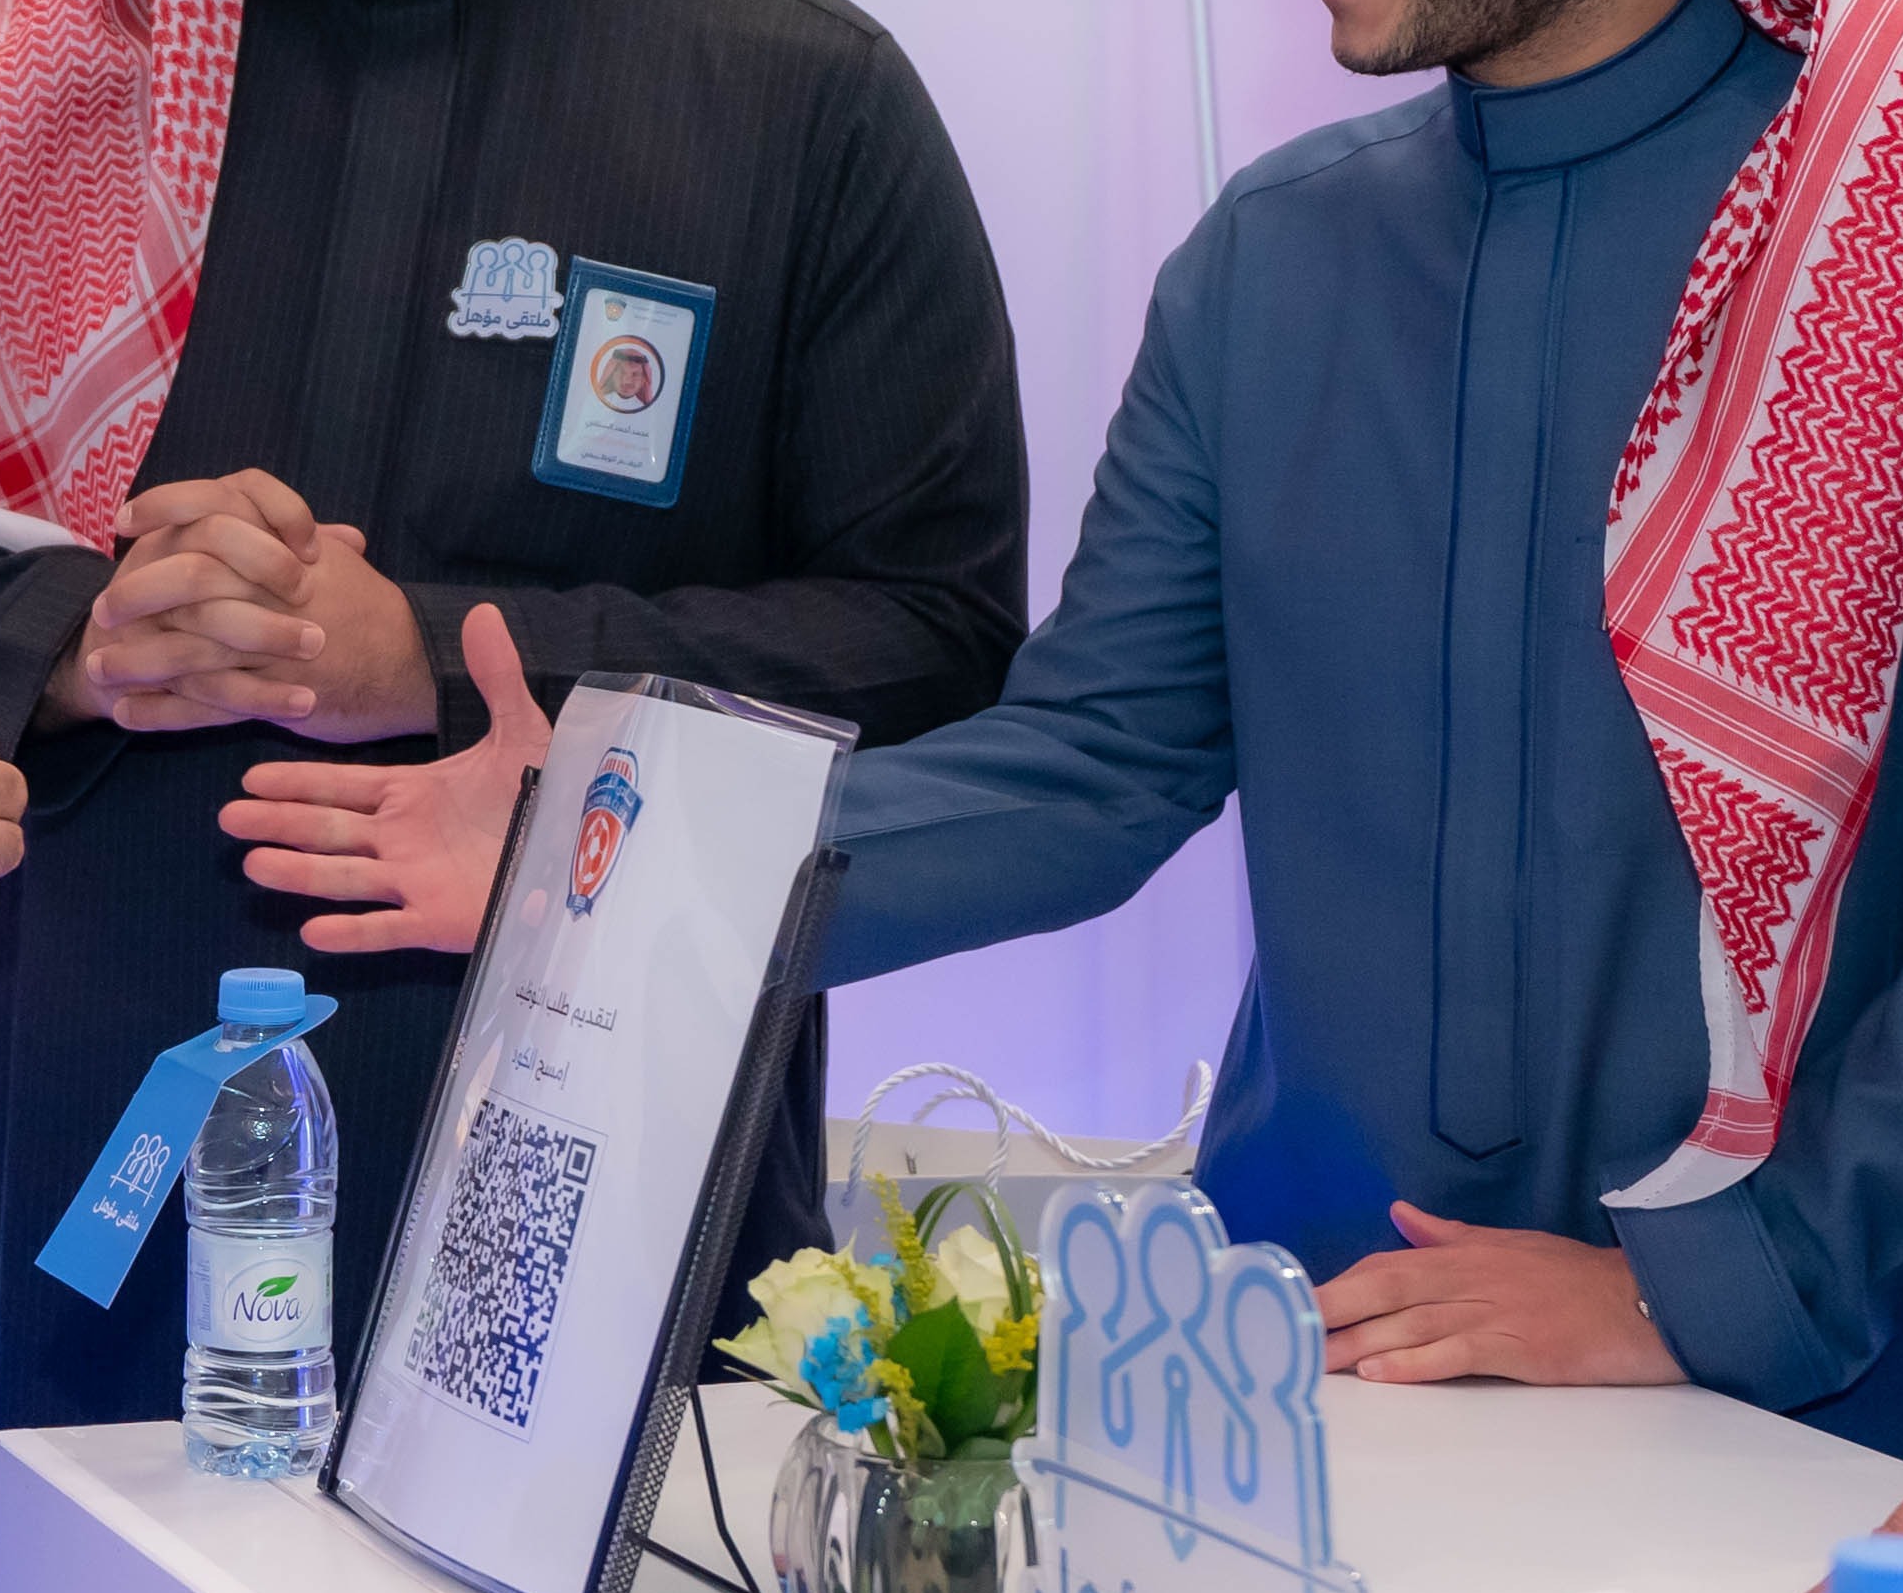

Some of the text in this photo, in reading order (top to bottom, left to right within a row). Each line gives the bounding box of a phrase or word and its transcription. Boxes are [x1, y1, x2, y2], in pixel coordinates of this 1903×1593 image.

[456, 307, 552, 330] ملتقى مؤهل
[545, 990, 570, 1017] طلب
[569, 1008, 617, 1031] لتقديم
[115, 1209, 140, 1232] ملتقى
[233, 1290, 301, 1322] Nova
